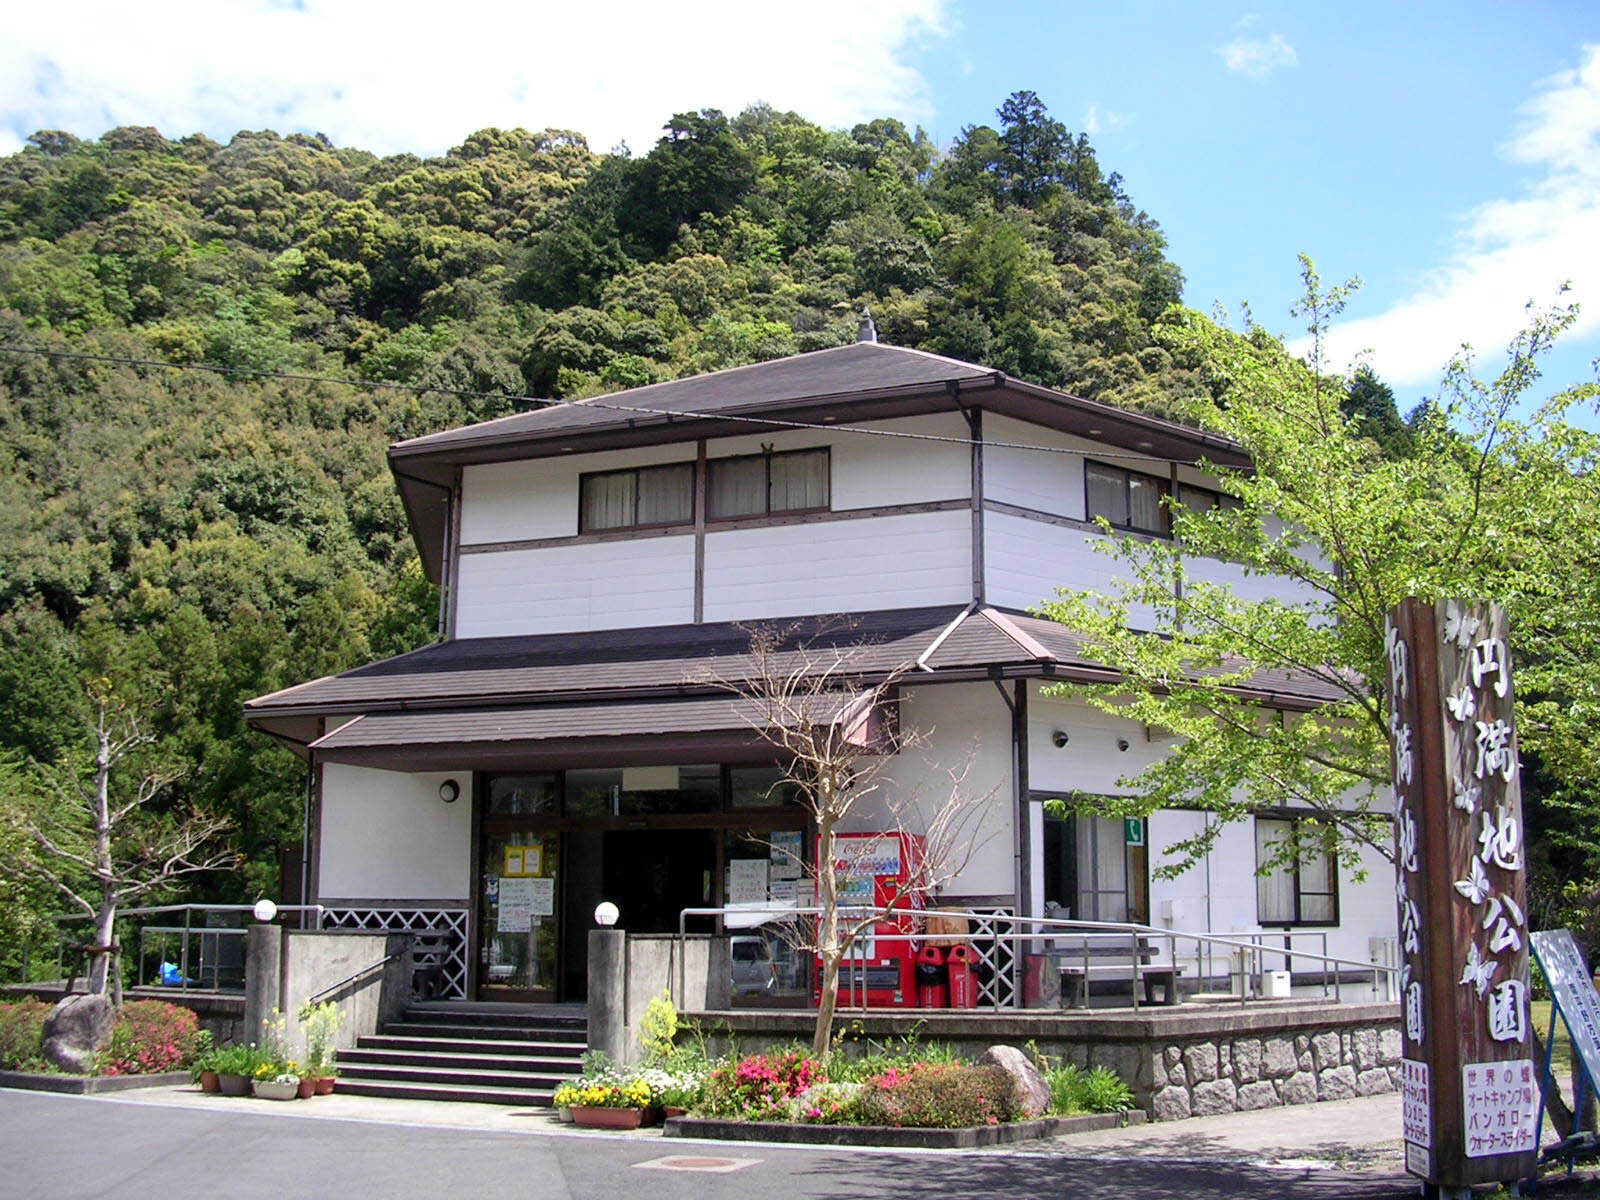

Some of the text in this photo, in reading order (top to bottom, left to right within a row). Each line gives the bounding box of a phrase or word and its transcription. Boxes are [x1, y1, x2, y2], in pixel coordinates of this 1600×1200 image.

[1471, 637, 1527, 1044] 円満地公園
[1469, 1110, 1531, 1130] バンガロー
